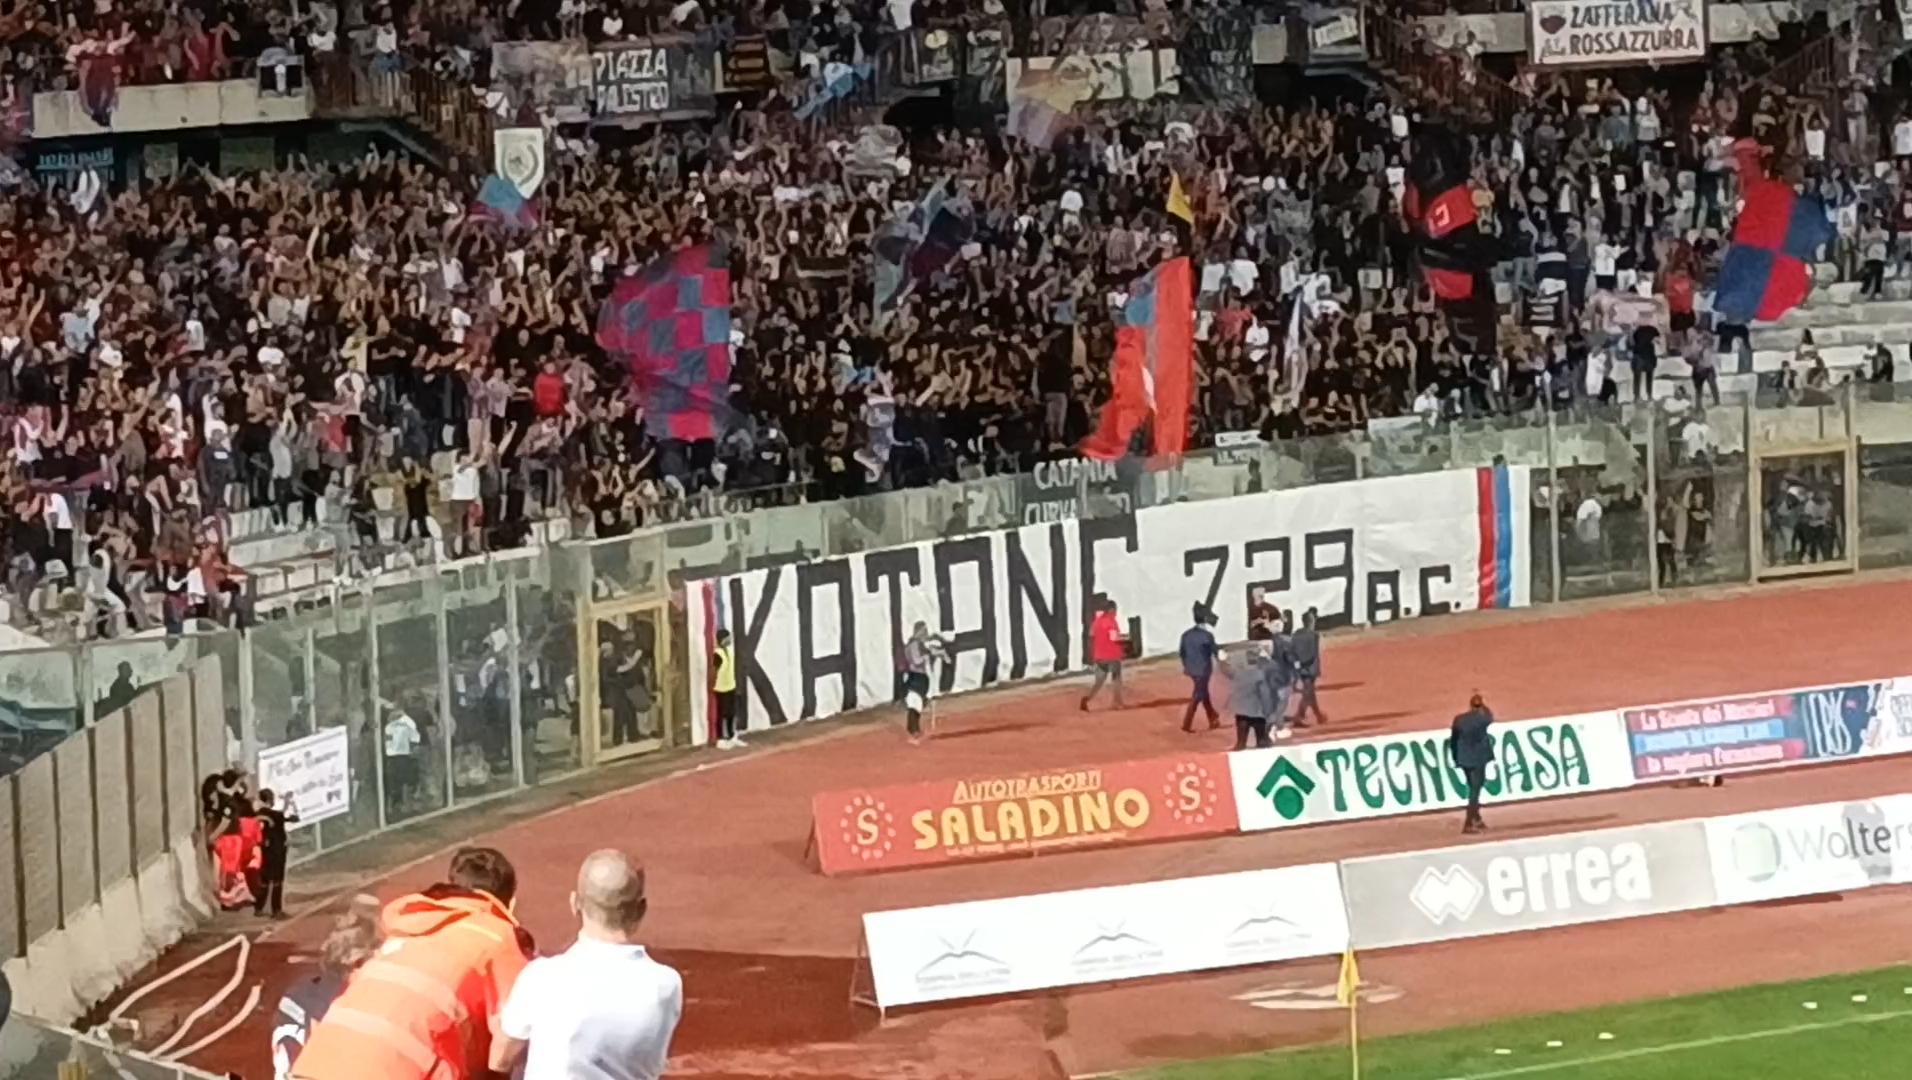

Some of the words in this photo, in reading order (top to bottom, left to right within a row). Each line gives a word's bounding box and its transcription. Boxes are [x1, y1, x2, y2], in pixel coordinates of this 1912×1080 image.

[592, 48, 669, 81] PIAZZA
[1570, 28, 1699, 55] ROSSAZZURRA
[1184, 528, 1354, 640] 729
[911, 788, 1150, 850] SALADINO
[1487, 841, 1652, 916] errea
